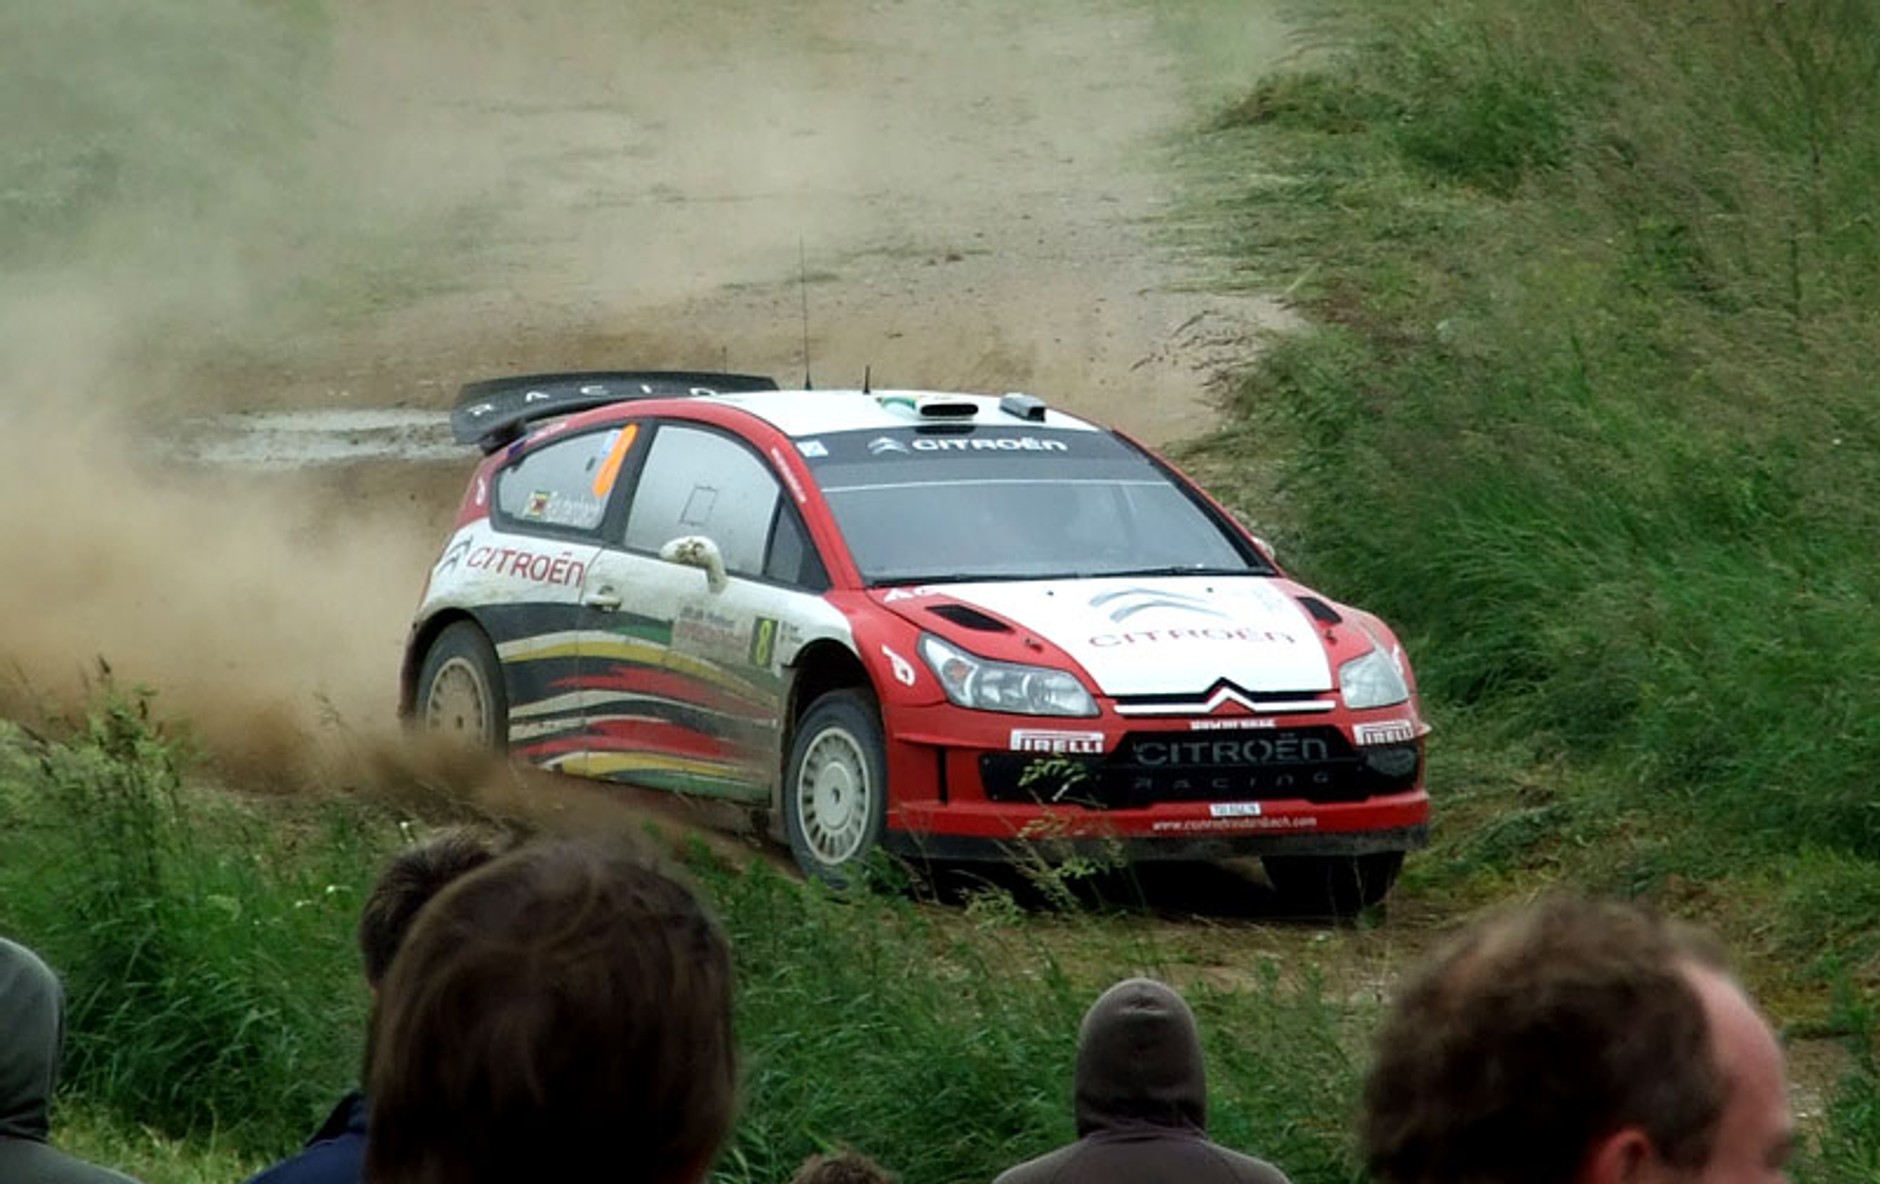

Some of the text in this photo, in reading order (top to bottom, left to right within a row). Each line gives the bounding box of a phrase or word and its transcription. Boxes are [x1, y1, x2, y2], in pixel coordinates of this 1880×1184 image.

[467, 547, 584, 588] CITROËN
[756, 619, 772, 667] 8
[1010, 728, 1105, 754] PIRELLI
[1352, 719, 1414, 745] PIRELLI
